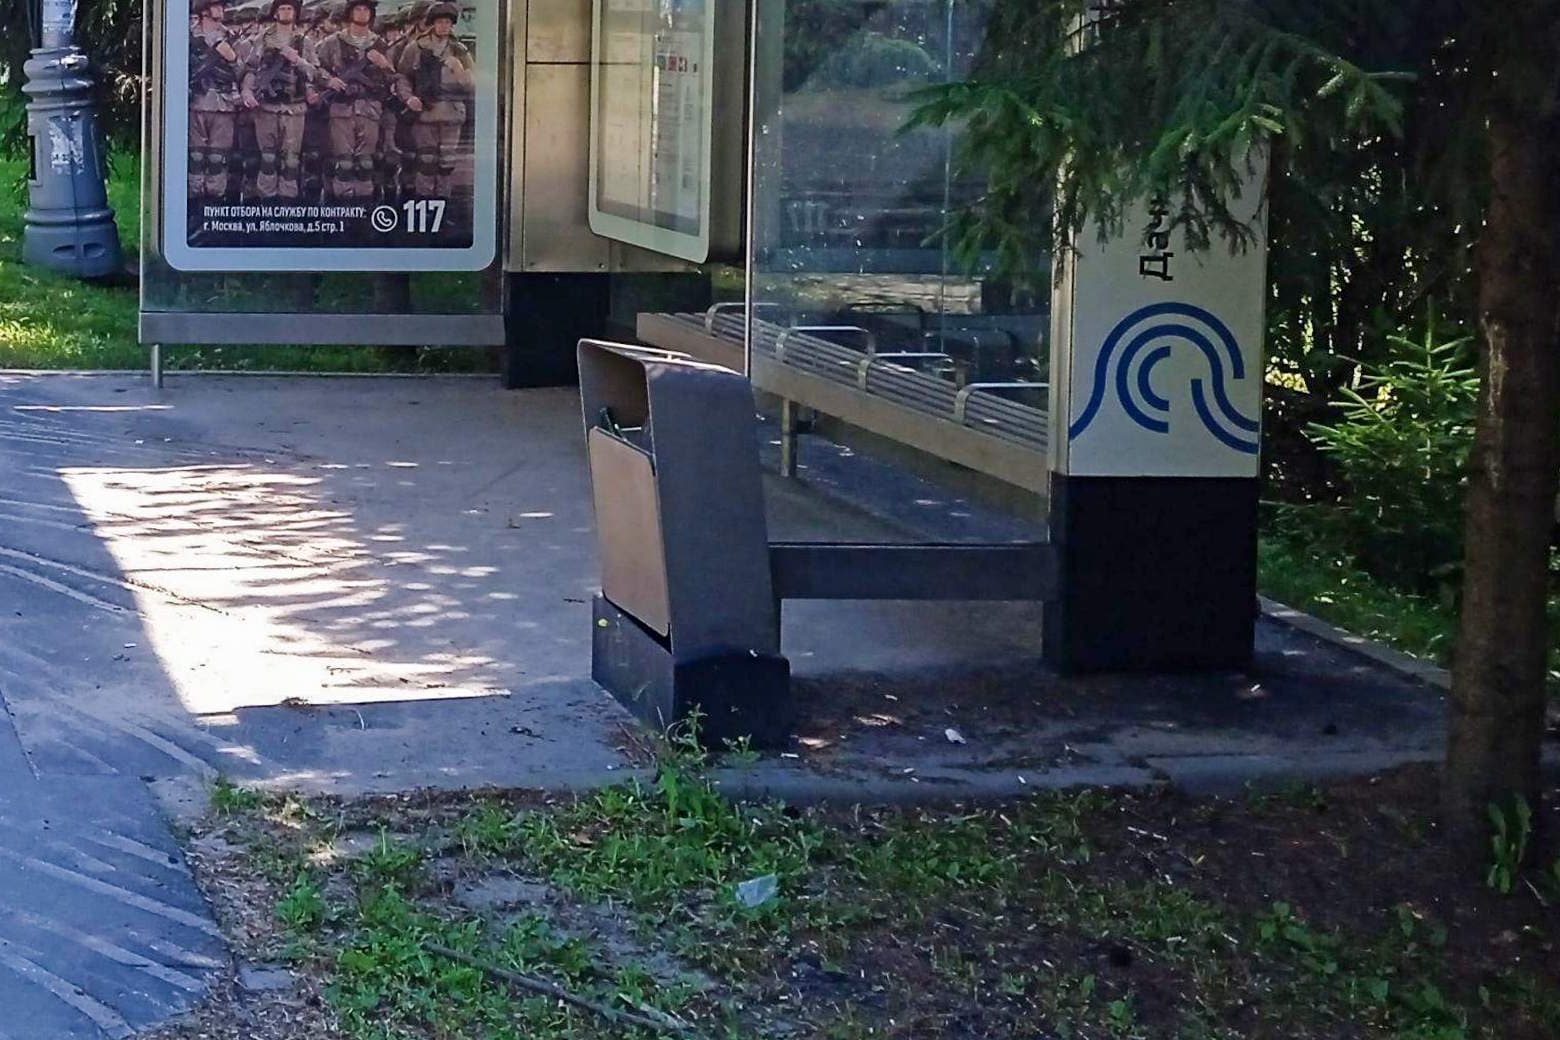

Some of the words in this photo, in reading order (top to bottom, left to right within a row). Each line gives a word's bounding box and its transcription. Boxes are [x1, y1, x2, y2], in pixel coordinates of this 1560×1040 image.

[203, 206, 230, 217] ПУНКТ
[231, 206, 260, 217] ОТБОРА
[261, 206, 273, 217] НА
[274, 206, 307, 218] СЛУЖБУ
[308, 206, 319, 218] ПО
[320, 206, 367, 218] КОНТРАКТУ:
[403, 200, 446, 233] 117
[203, 222, 210, 231] г.
[211, 221, 245, 232] Москва,
[246, 222, 258, 234] ул.
[259, 220, 306, 233] Яблочкова,
[321, 222, 338, 234] стр.
[339, 220, 345, 232] 1
